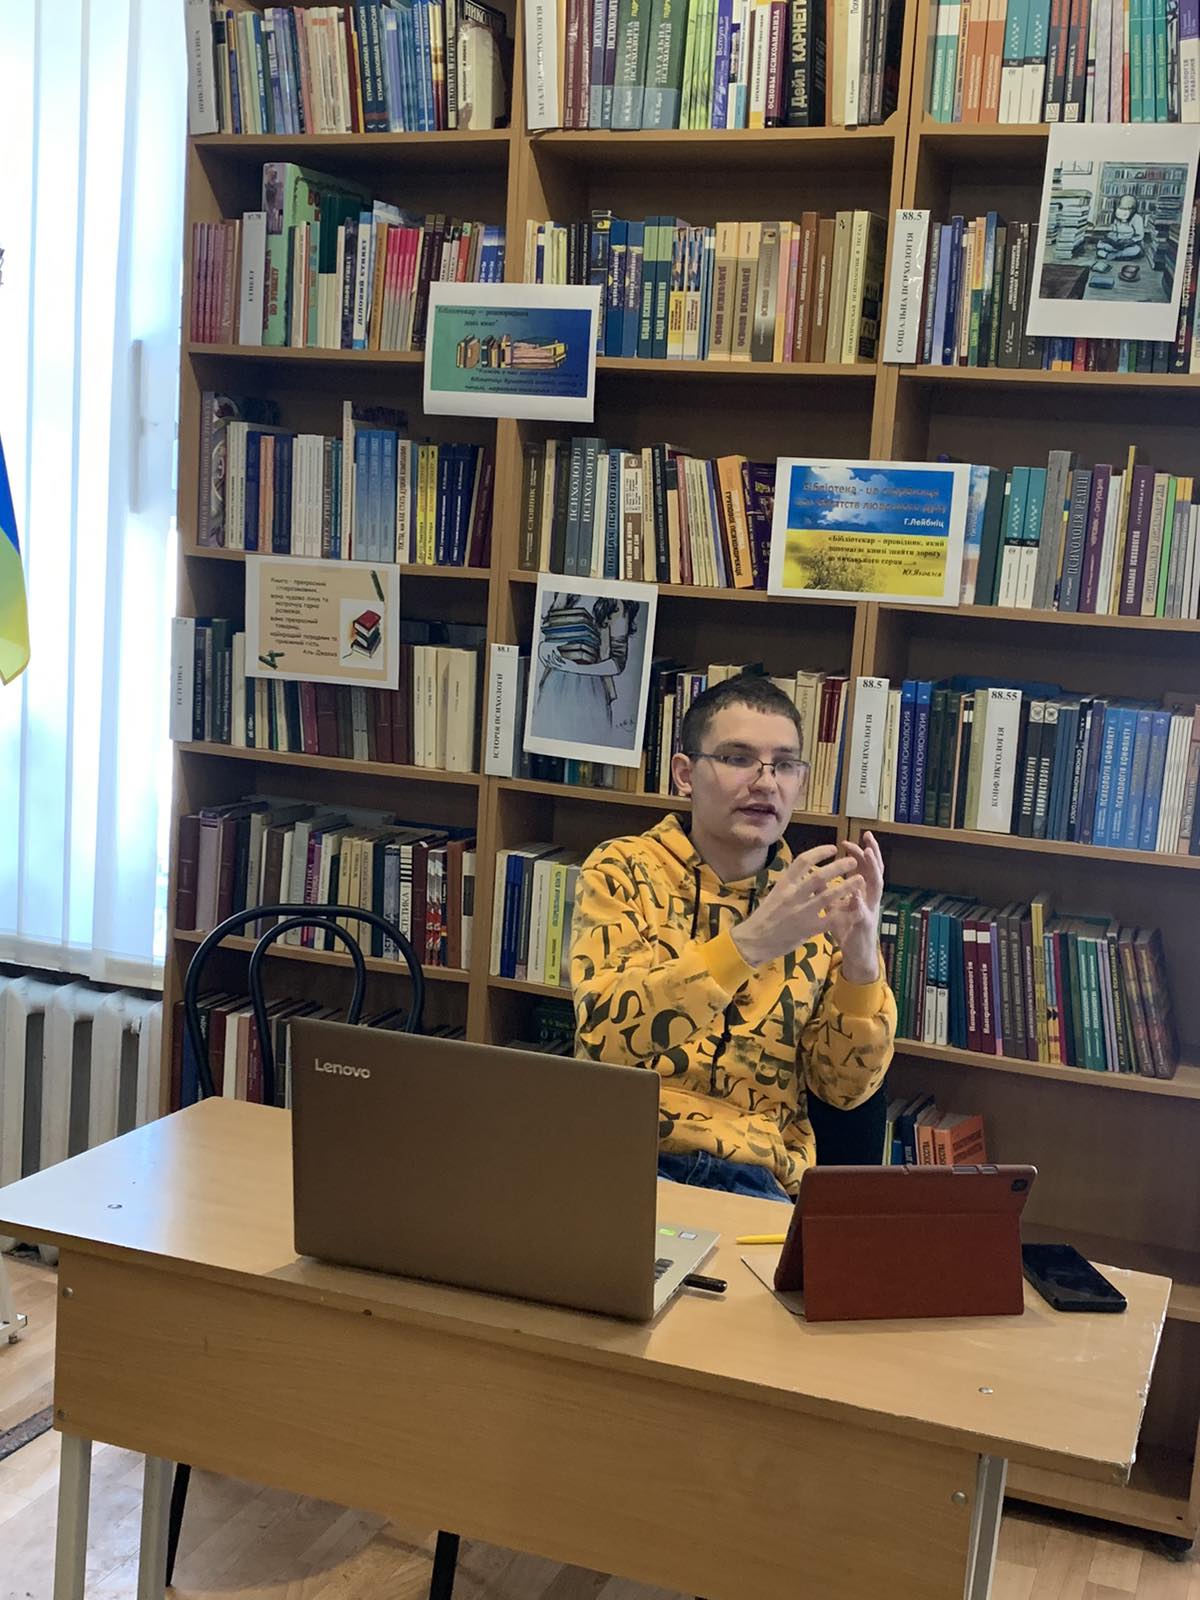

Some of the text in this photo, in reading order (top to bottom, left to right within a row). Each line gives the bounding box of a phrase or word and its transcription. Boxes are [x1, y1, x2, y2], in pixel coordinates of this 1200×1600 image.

[791, 69, 808, 108] Дейл
[901, 211, 922, 220] 88.5
[357, 280, 366, 326] ДІЛОВИЙ
[527, 488, 536, 531] СЛОВНИК
[582, 447, 595, 523] ПСИХОЛОГІЯ
[607, 453, 618, 572] ОБЩАЯ ПСИХОЛОГИЯ
[903, 517, 945, 529] Г.Лейбніц
[1067, 476, 1090, 575] ПСИХОЛОГІЯ РЕЛІГІЇ
[1125, 568, 1137, 604] СОЦИАЛЬНАЯ
[493, 672, 504, 759] ІСТОРІЯ ПСИХОЛОГІЇ
[859, 713, 873, 795] ЕТНОПСИХОЛОГІЯ
[898, 710, 911, 815] ЭТНИЧЕСКАЯ ПСИХОЛОГИЯ
[912, 712, 927, 816] ЭТНИЧЕСКАЯ ПСИХОЛОГИЯ
[1021, 756, 1037, 815] КОНФЛИКТОЛОГИЯ
[1035, 757, 1051, 817] КОНФЛИКТОЛОГИЯ
[1101, 725, 1117, 807] ПСИХОЛОГІЯ КОНФЛІКТУ
[1115, 727, 1132, 809] ПСИХОЛОГІЯ КОНФЛІКТУ
[314, 1058, 371, 1079] Lenovo
